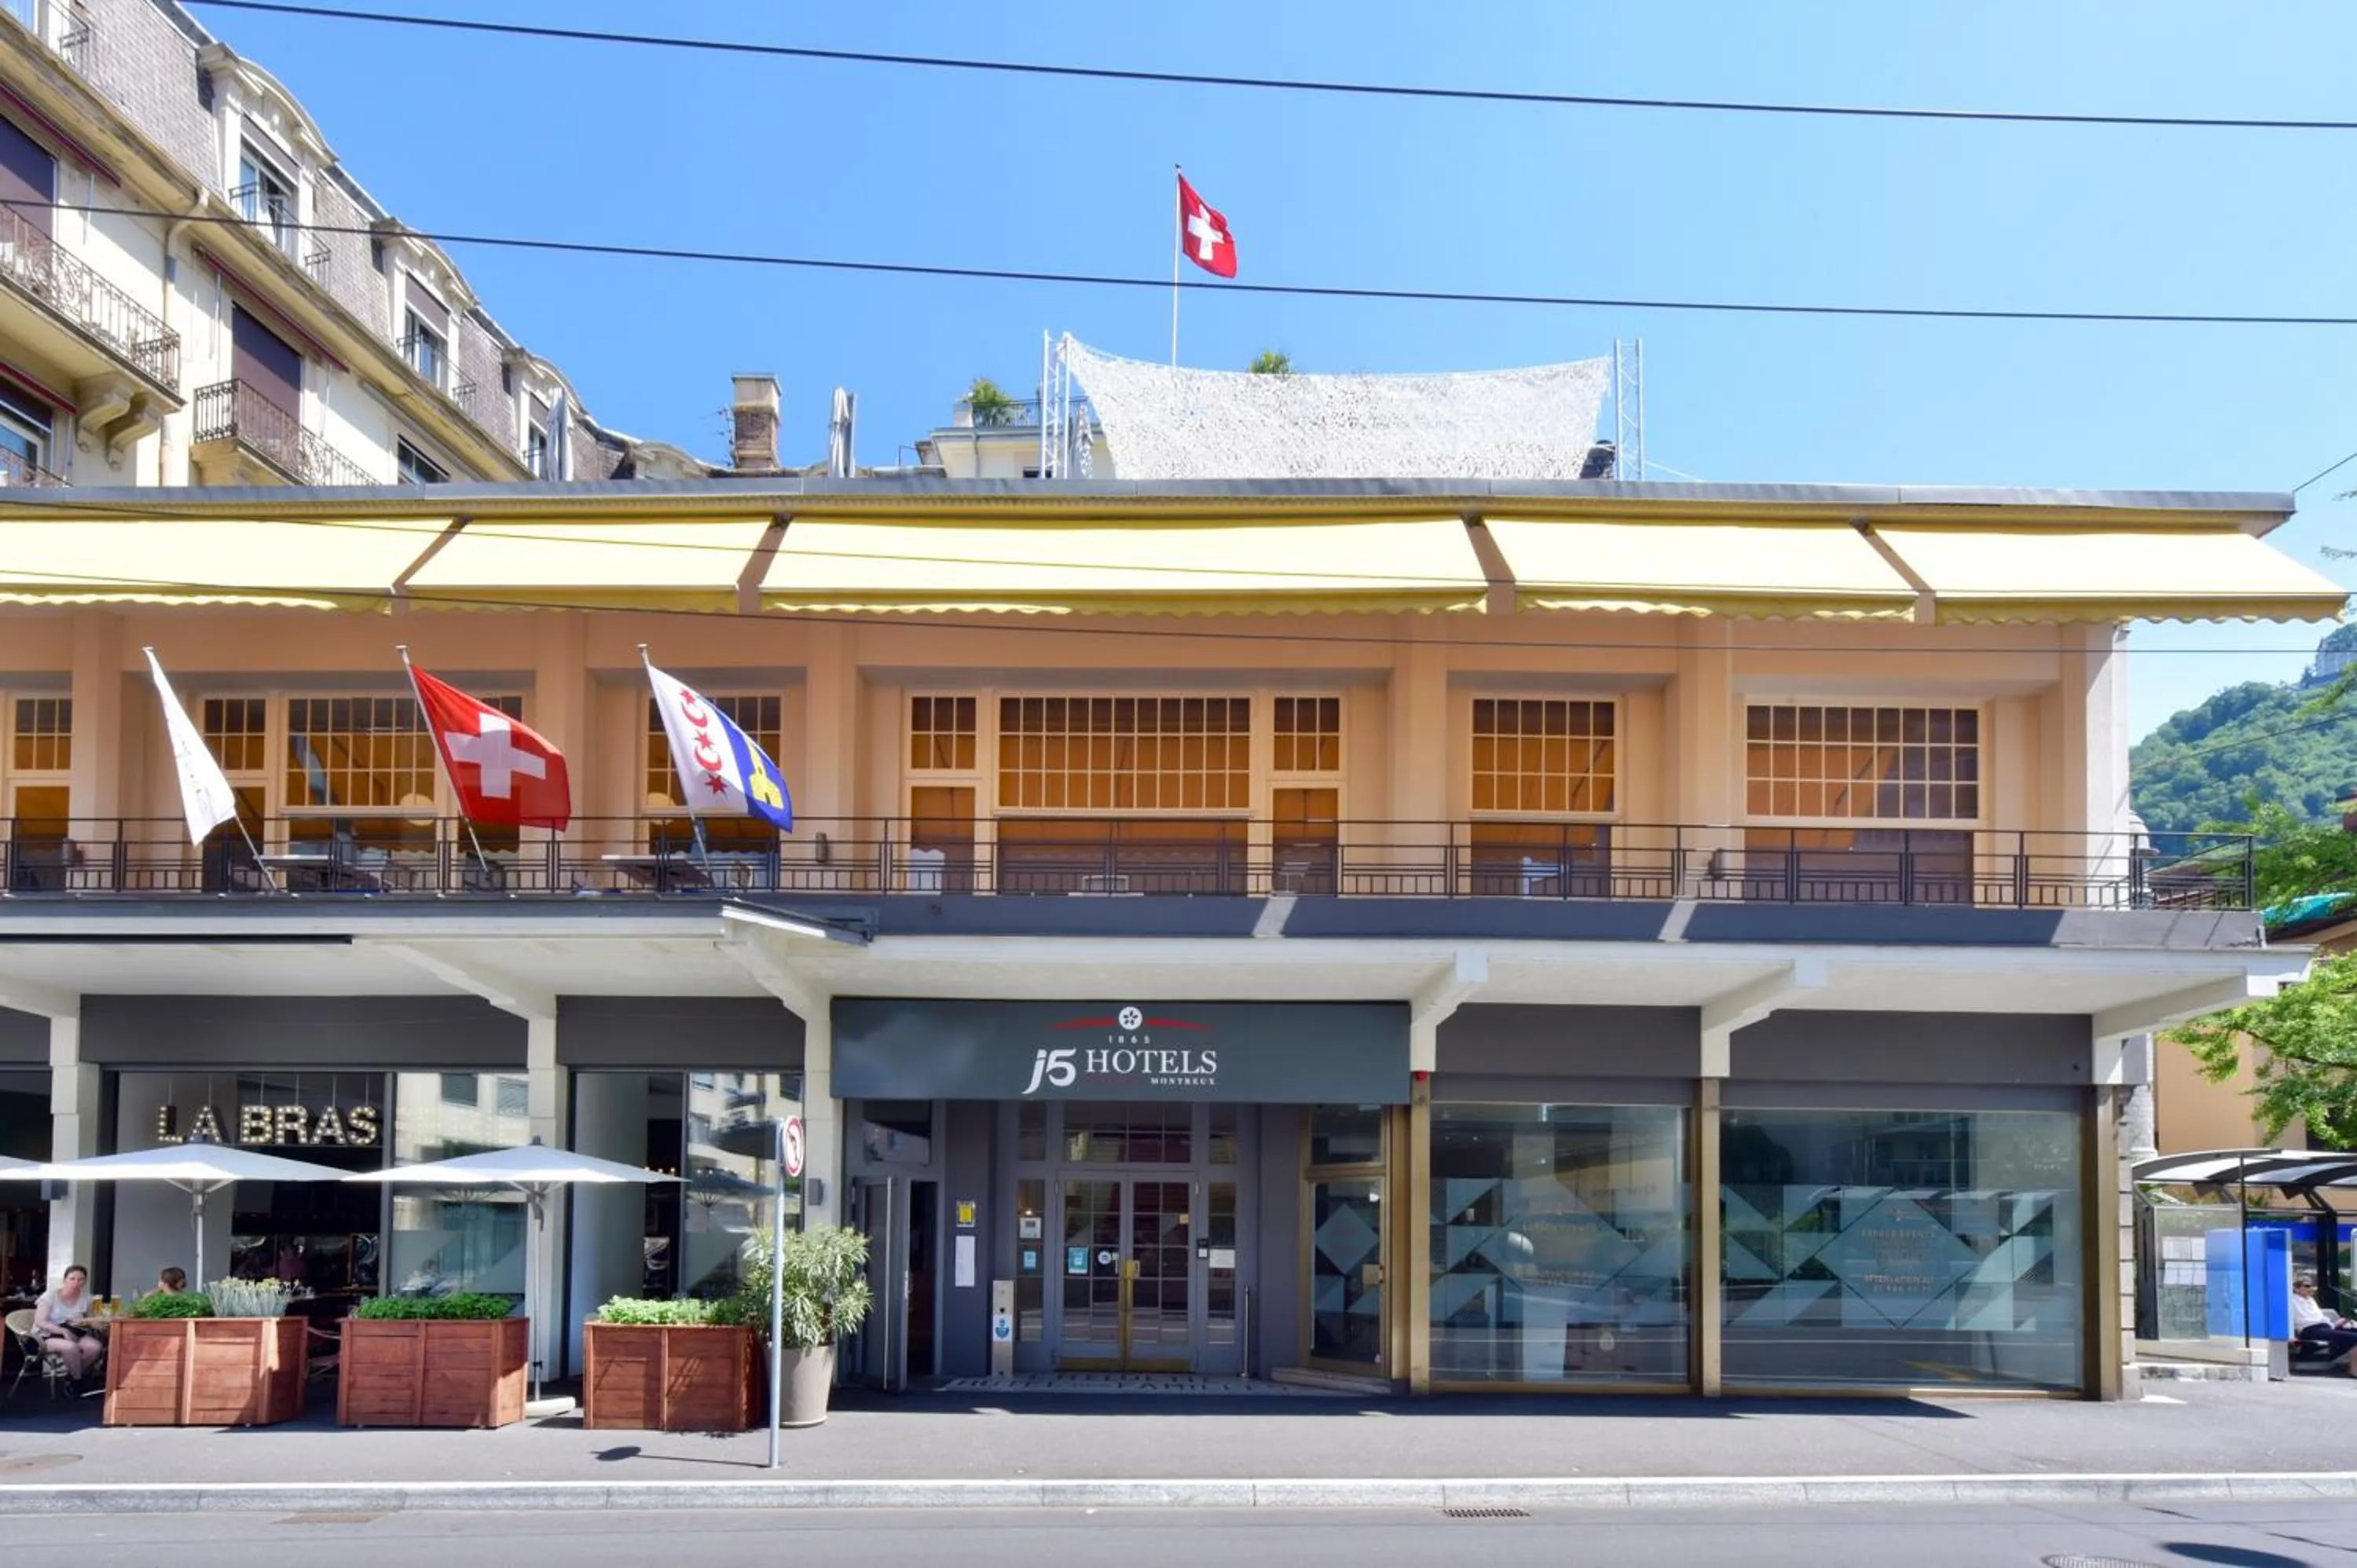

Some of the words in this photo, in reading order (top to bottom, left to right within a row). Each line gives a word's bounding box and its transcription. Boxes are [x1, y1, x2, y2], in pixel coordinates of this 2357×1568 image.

[1086, 1049, 1218, 1075] HOTELS
[1150, 1077, 1216, 1086] MONTREUX
[158, 1104, 223, 1144] LA
[240, 1104, 378, 1145] BRAS
